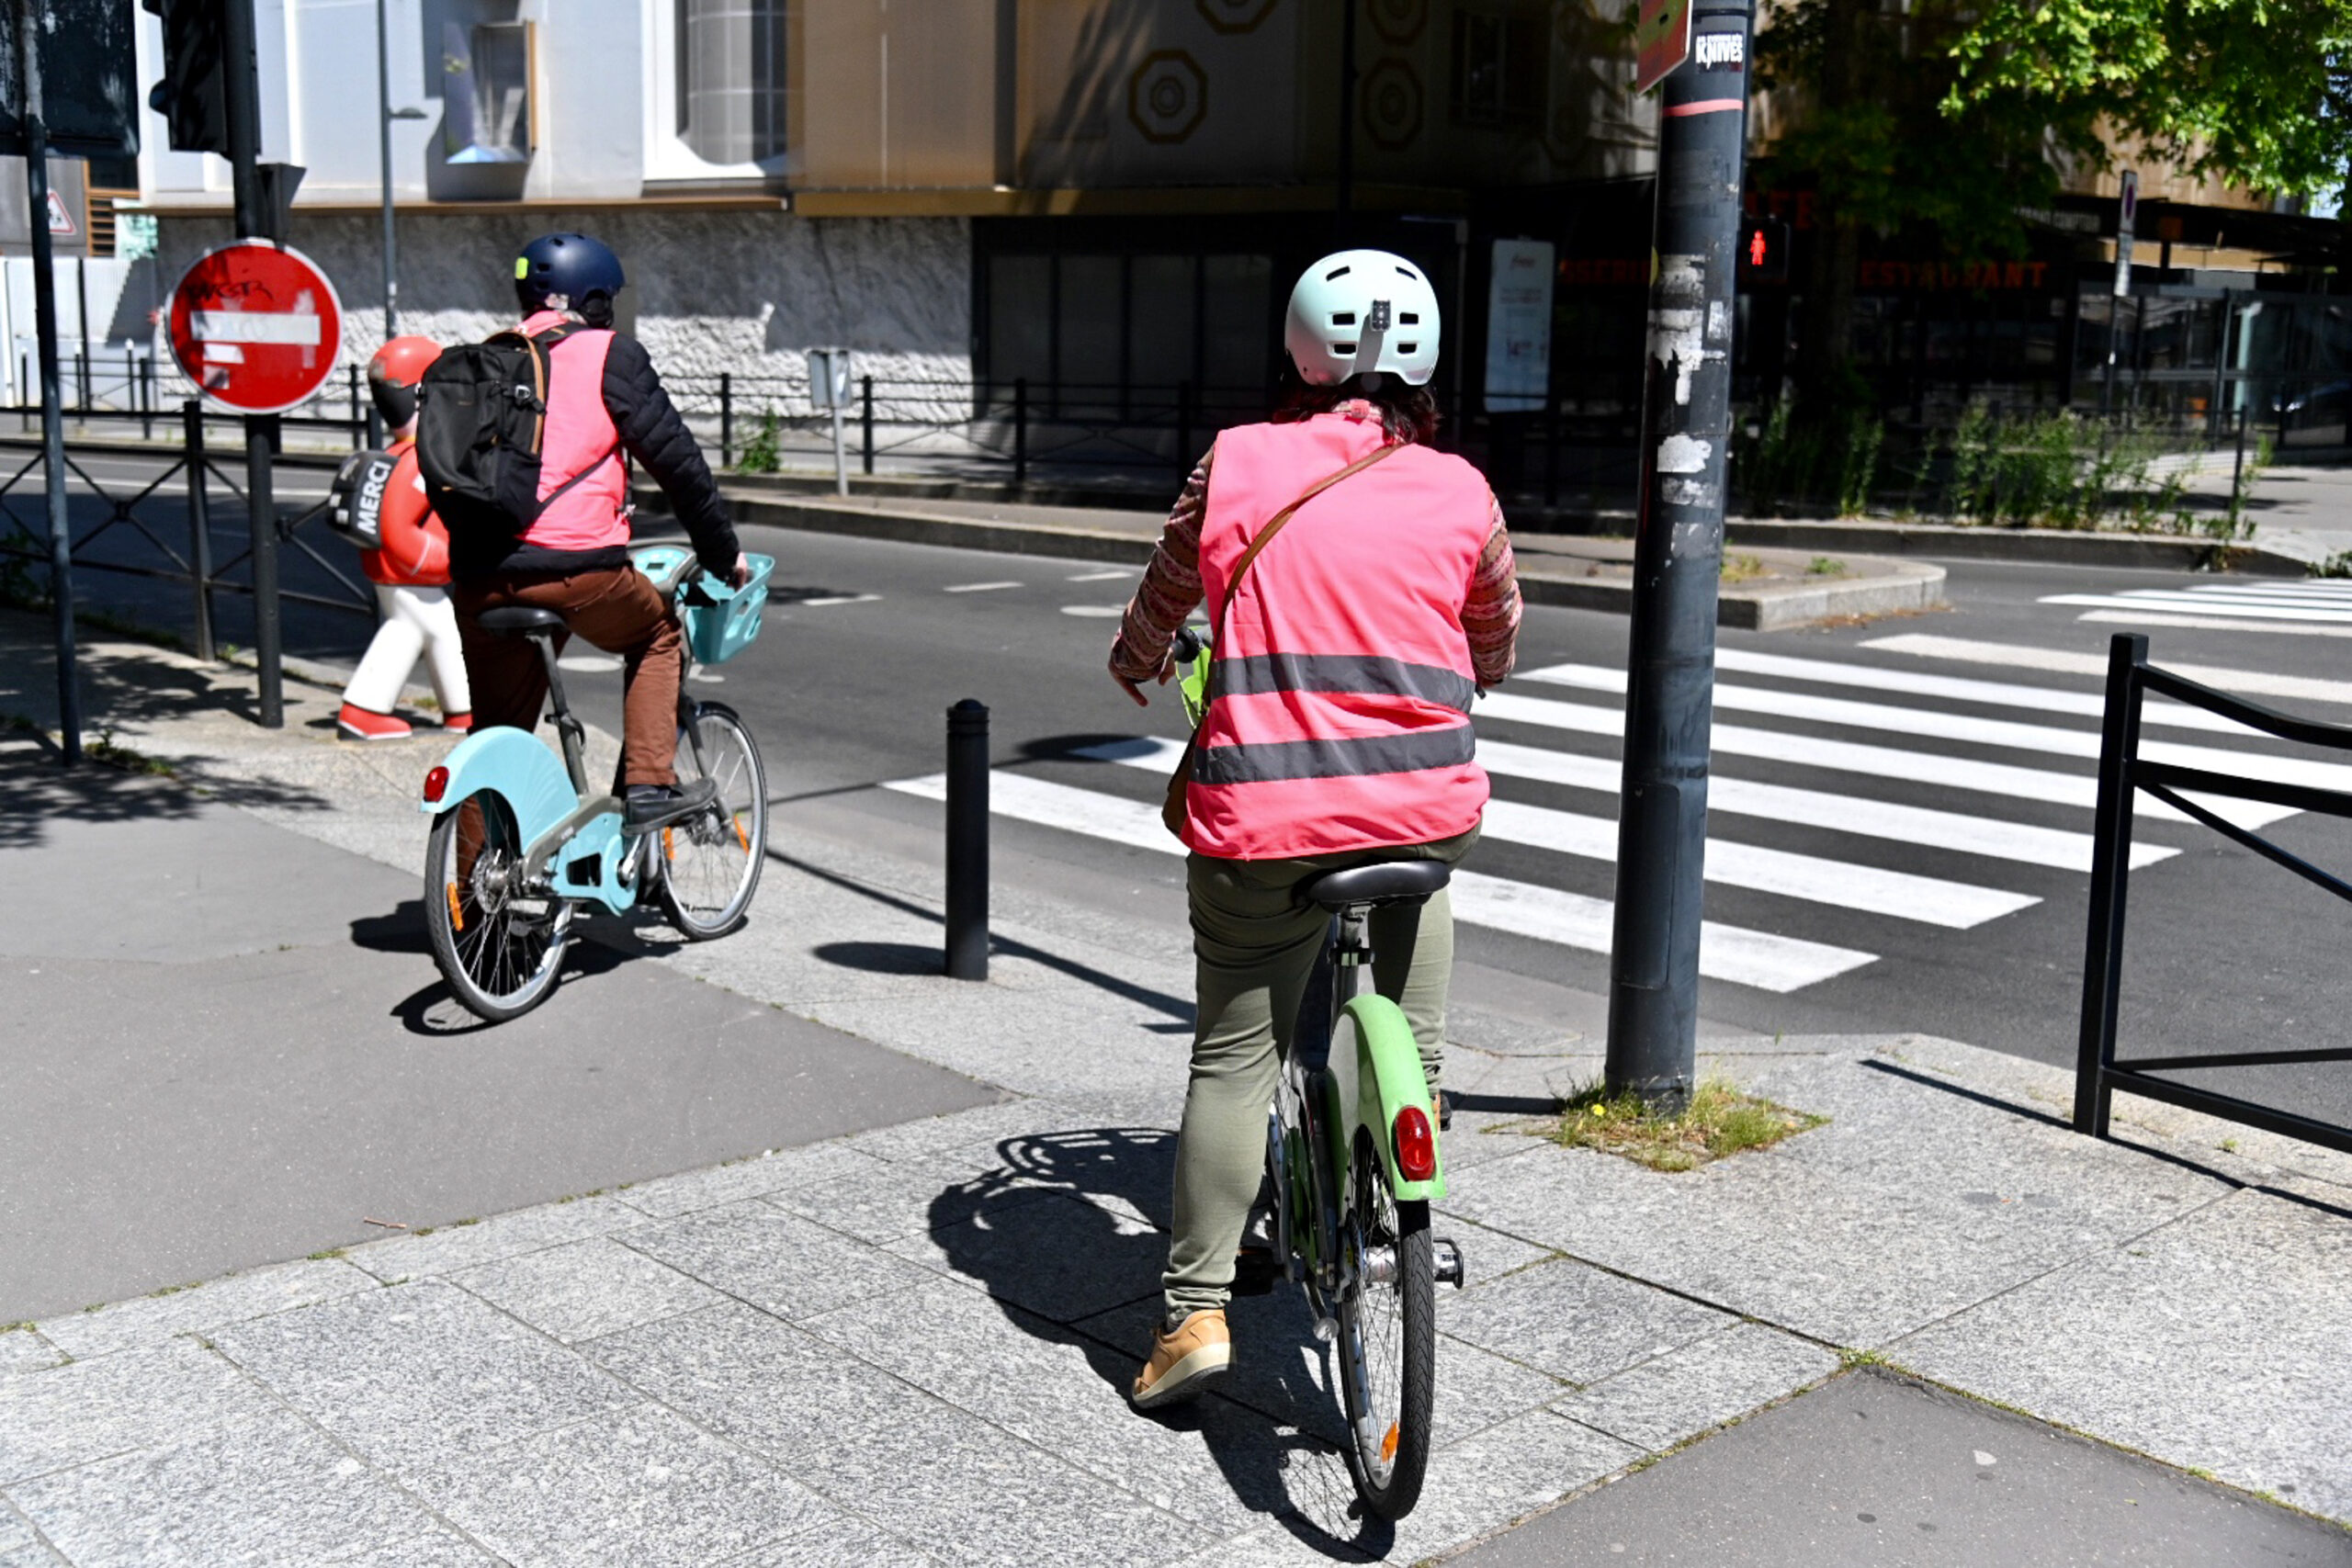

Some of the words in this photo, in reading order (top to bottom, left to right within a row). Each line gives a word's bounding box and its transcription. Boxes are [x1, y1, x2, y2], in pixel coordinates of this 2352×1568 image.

[1695, 40, 1743, 69] KNIVES
[1860, 258, 2050, 289] ESTAURANT
[356, 460, 392, 536] MERCI
